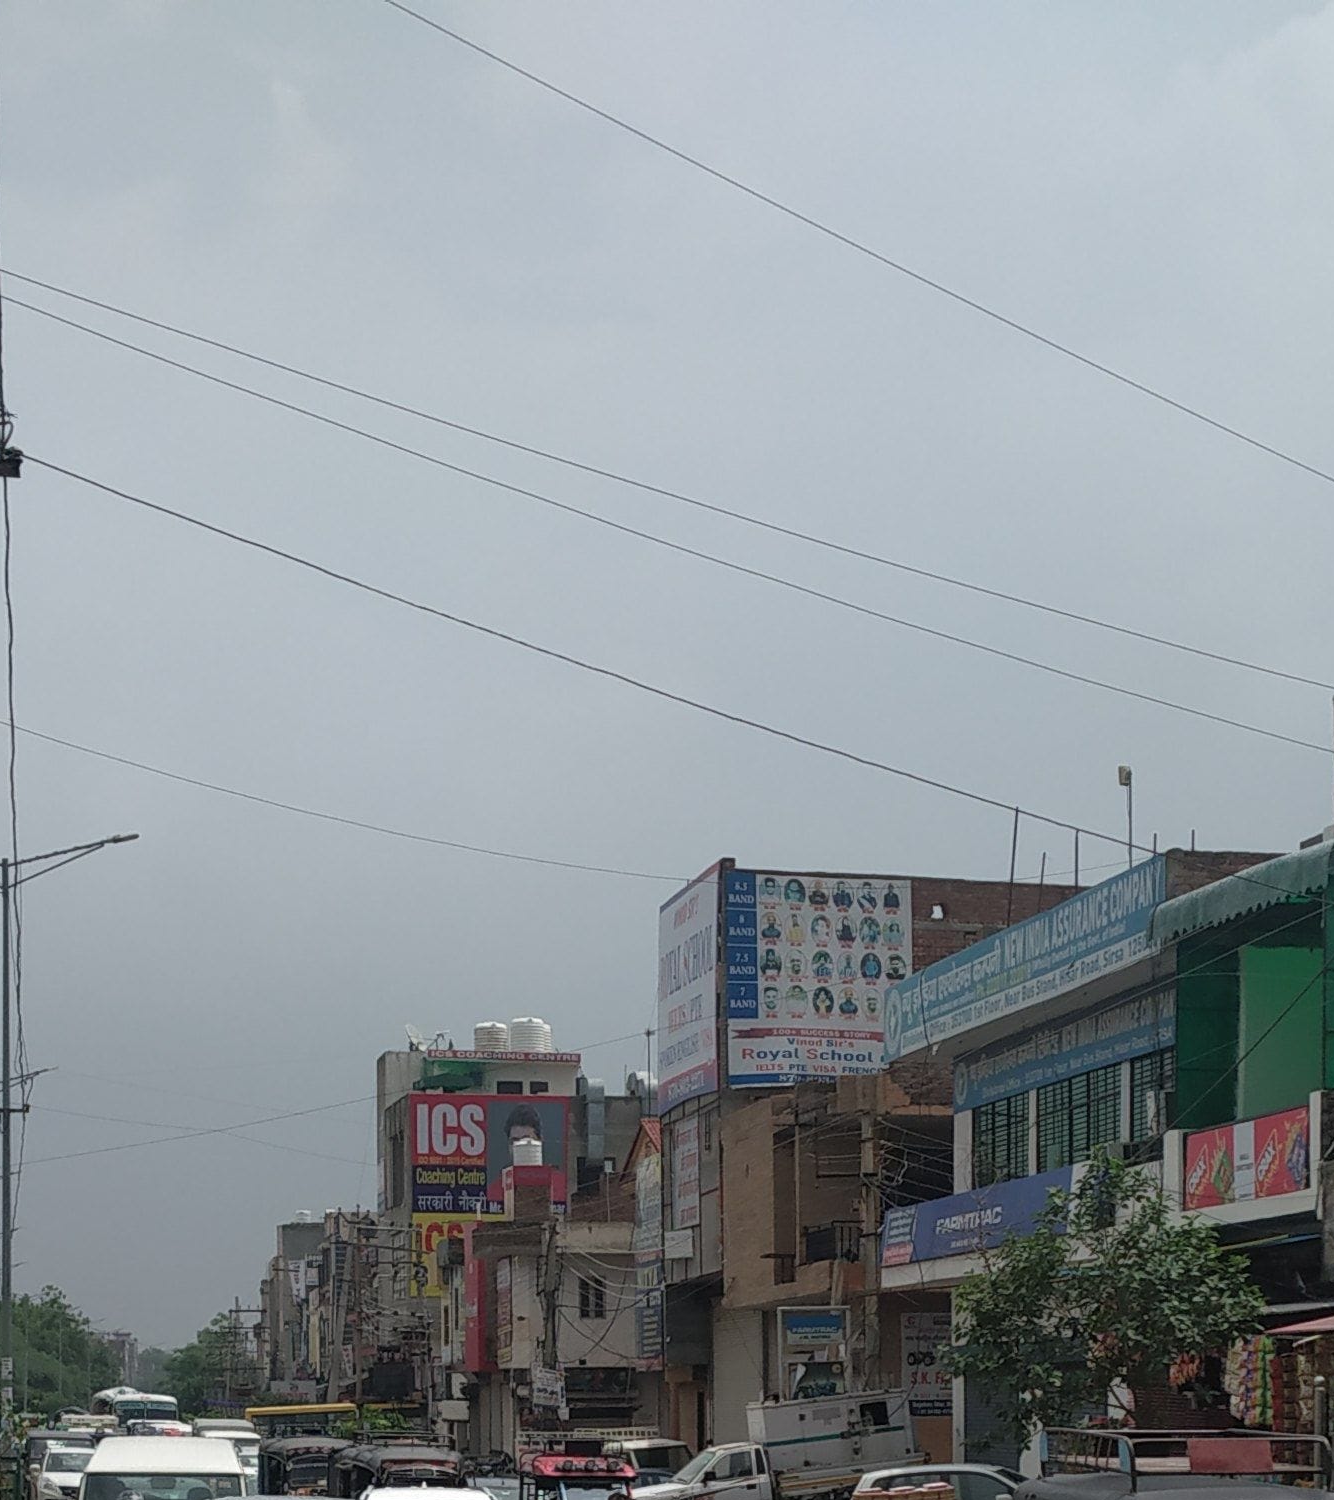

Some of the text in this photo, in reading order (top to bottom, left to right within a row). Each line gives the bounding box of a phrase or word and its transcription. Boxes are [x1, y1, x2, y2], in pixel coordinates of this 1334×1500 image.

[728, 893, 755, 905] BAND
[1003, 927, 1023, 970] NEW
[1051, 887, 1107, 949] ASSURANCE
[1110, 860, 1161, 923] COMPANY
[729, 926, 756, 937] BAND
[735, 952, 749, 963] 7.5
[729, 965, 756, 976] BAND
[1022, 982, 1033, 1001] Bus
[1081, 955, 1100, 978] Road,
[1103, 944, 1124, 968] Sirsa
[740, 987, 746, 996] 7
[729, 998, 756, 1009] BAND
[772, 1028, 872, 1040] 100+ SUCCESS STORY
[787, 1037, 823, 1047] Vinod
[431, 1050, 580, 1062] ICS COACHING CENTRE
[741, 1047, 874, 1063] Royal School
[756, 1063, 785, 1072] IELTS
[788, 1064, 808, 1072] PTE
[813, 1065, 838, 1073] VISA
[416, 1103, 487, 1156] ICS
[416, 1168, 486, 1188] Coaching Centre
[417, 1190, 454, 1211] सरकारी
